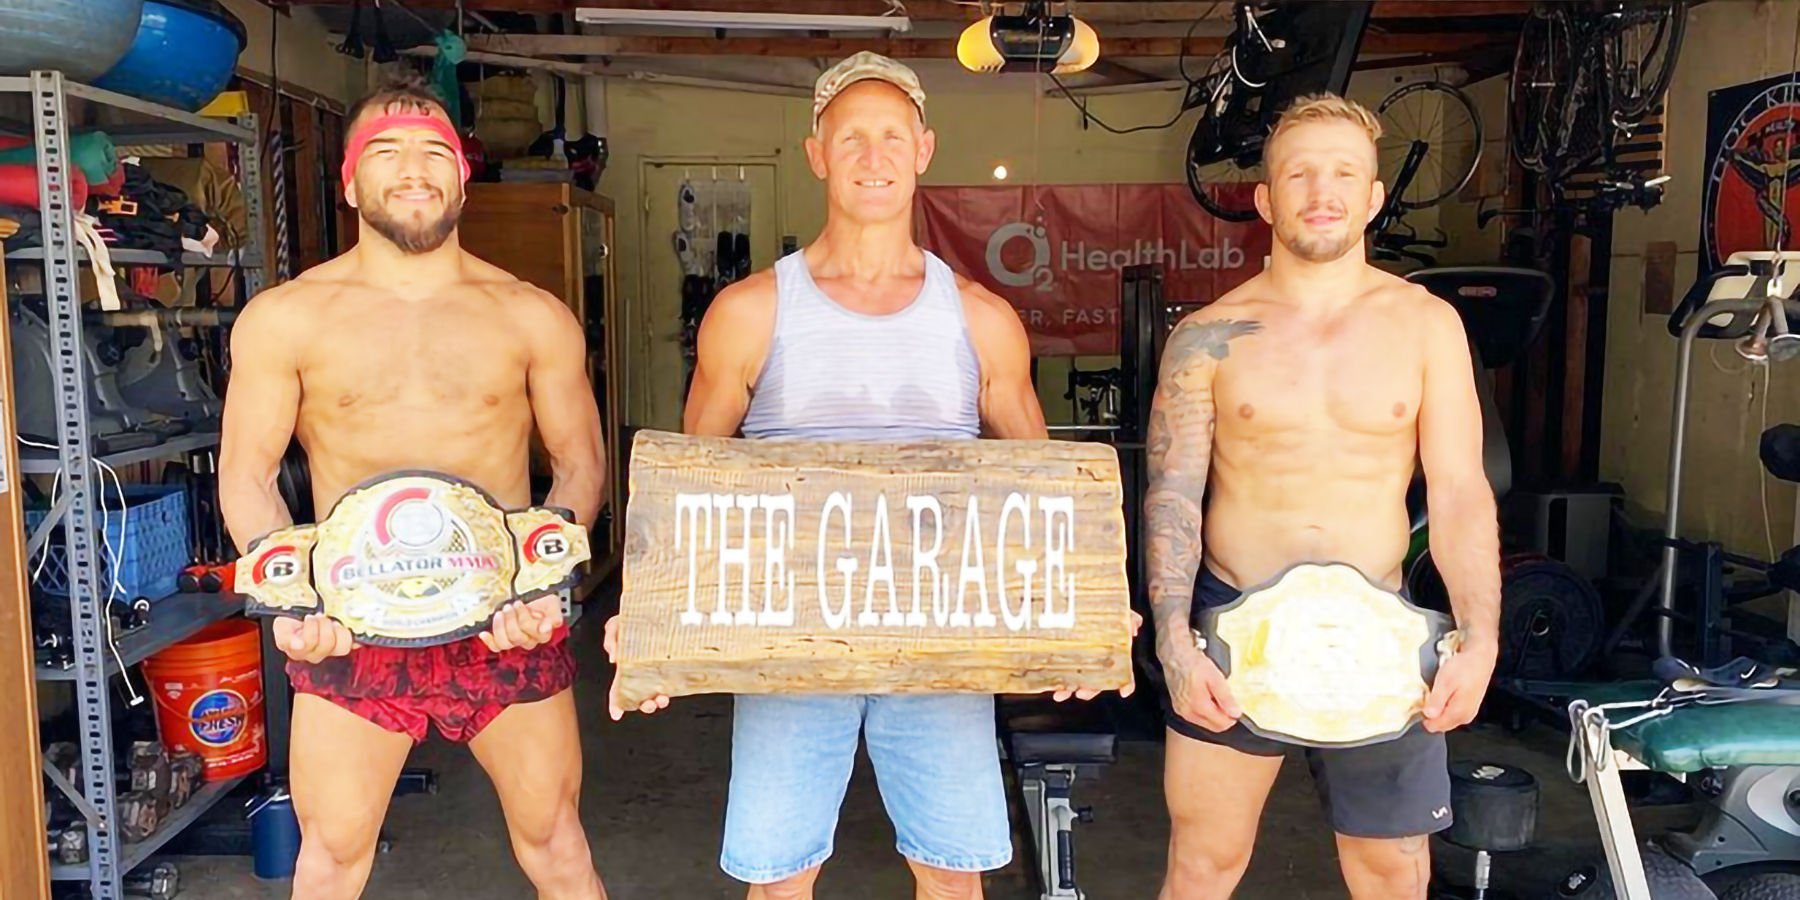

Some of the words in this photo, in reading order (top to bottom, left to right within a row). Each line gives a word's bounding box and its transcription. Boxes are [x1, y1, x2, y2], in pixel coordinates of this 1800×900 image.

[1061, 237, 1245, 271] HealthLab
[343, 558, 442, 580] BELLATOR
[675, 493, 795, 626] THE
[817, 491, 1075, 631] GARAGE
